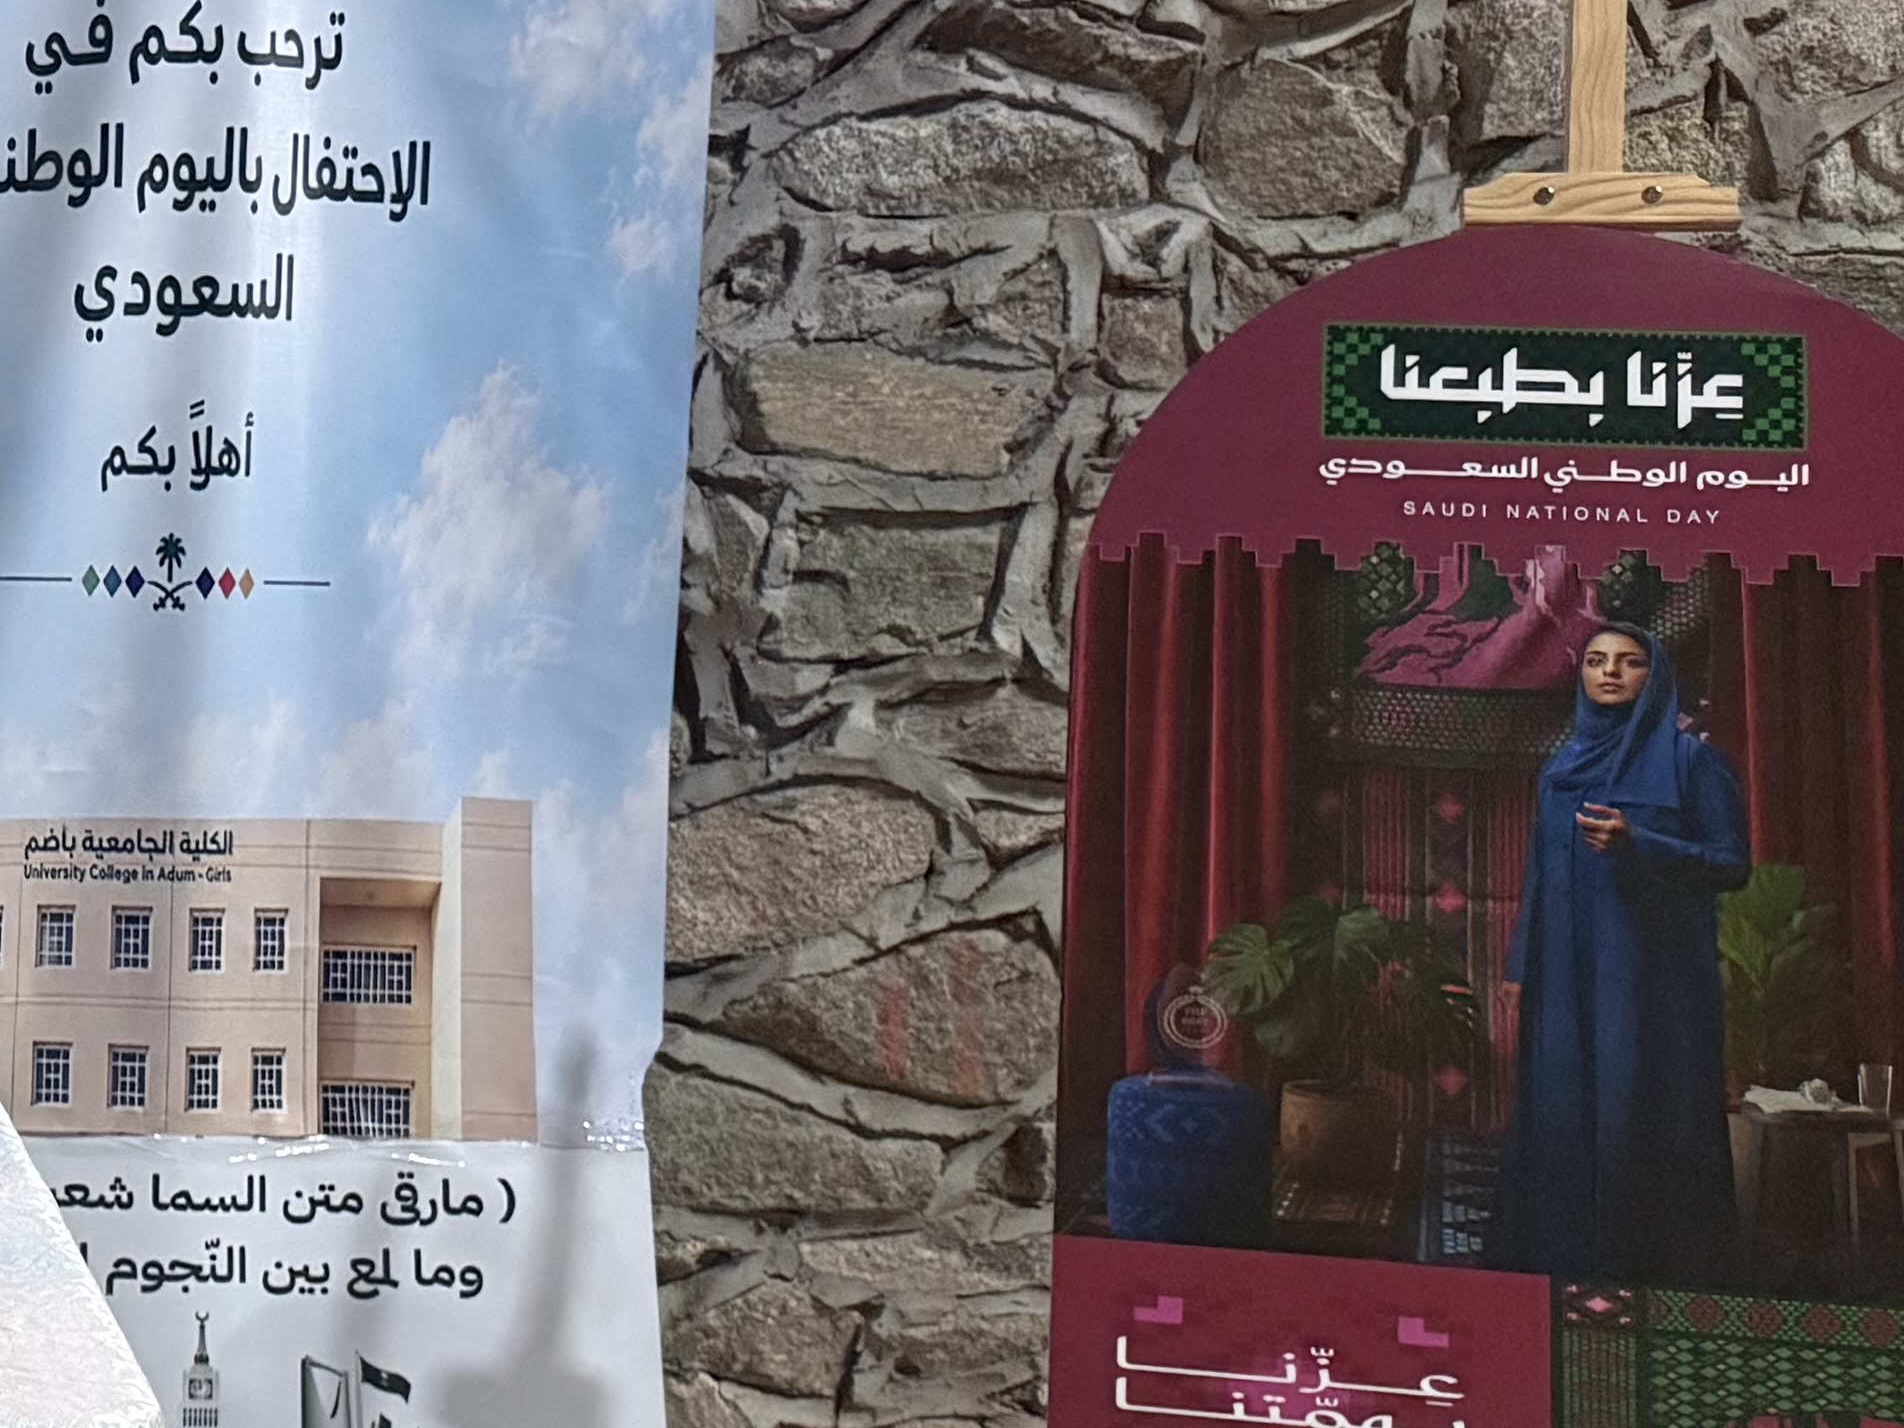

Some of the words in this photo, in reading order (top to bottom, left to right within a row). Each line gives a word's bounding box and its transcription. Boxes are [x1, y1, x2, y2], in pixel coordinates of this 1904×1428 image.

[237, 11, 345, 90] ترحب
[136, 125, 263, 214] باليوم
[74, 252, 294, 343] السعودي
[1379, 344, 1605, 427] بطبعنا
[101, 425, 176, 493] بكم
[1318, 456, 1539, 487] السعودي
[1543, 459, 1688, 494] الوطني
[1695, 463, 1811, 493] اليوم
[1402, 500, 1489, 518] SAUDI
[1506, 505, 1649, 524] NATIONAL
[1666, 509, 1721, 526] DAY
[82, 828, 174, 861] الجامعية
[179, 829, 234, 862] الكلية
[24, 864, 86, 882] University
[91, 865, 138, 884] College
[157, 866, 195, 882] Adum
[206, 867, 232, 882] Girls
[151, 1173, 266, 1213] السما
[282, 1183, 364, 1224] متن
[262, 1257, 331, 1296] بين
[413, 1249, 485, 1300] وما
